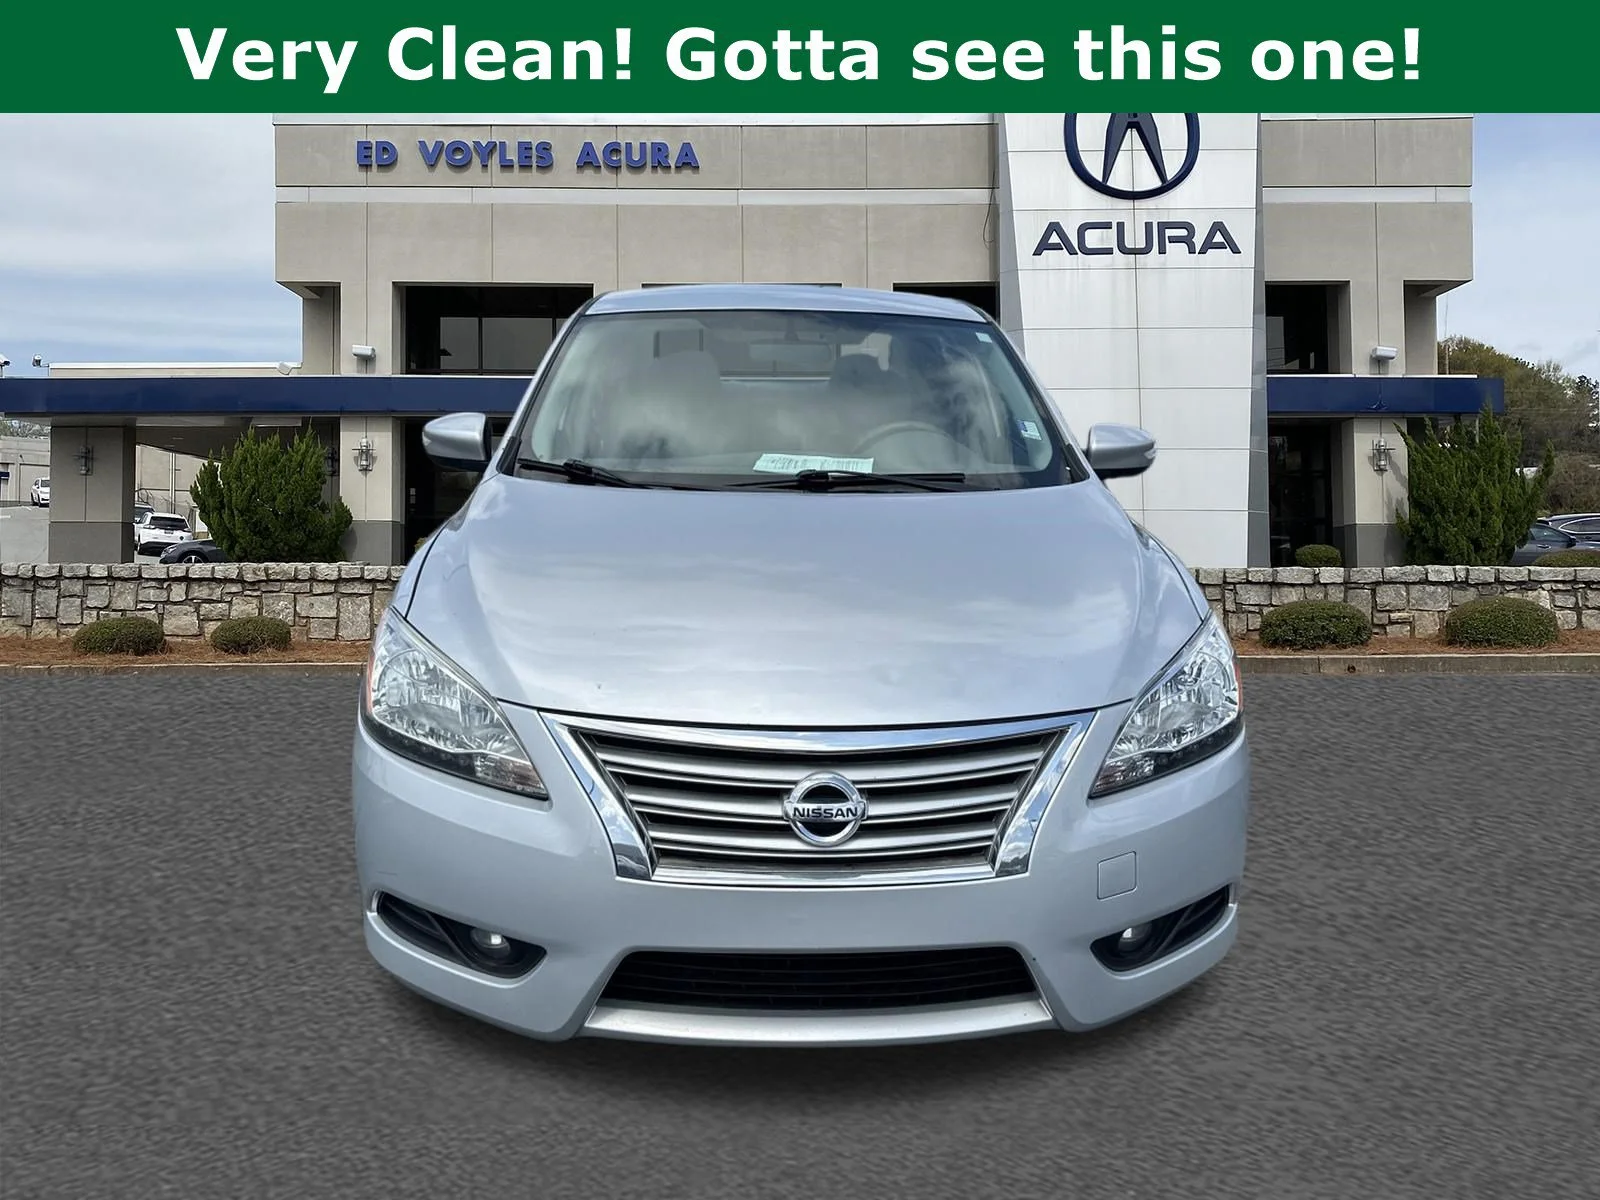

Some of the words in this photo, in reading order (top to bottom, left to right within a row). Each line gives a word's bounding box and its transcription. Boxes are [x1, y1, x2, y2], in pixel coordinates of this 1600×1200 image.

[356, 140, 398, 168] ED
[418, 140, 554, 168] VOYLES
[576, 140, 701, 169] ACURA
[1032, 221, 1242, 256] ACURA
[793, 807, 858, 818] NISSAN
